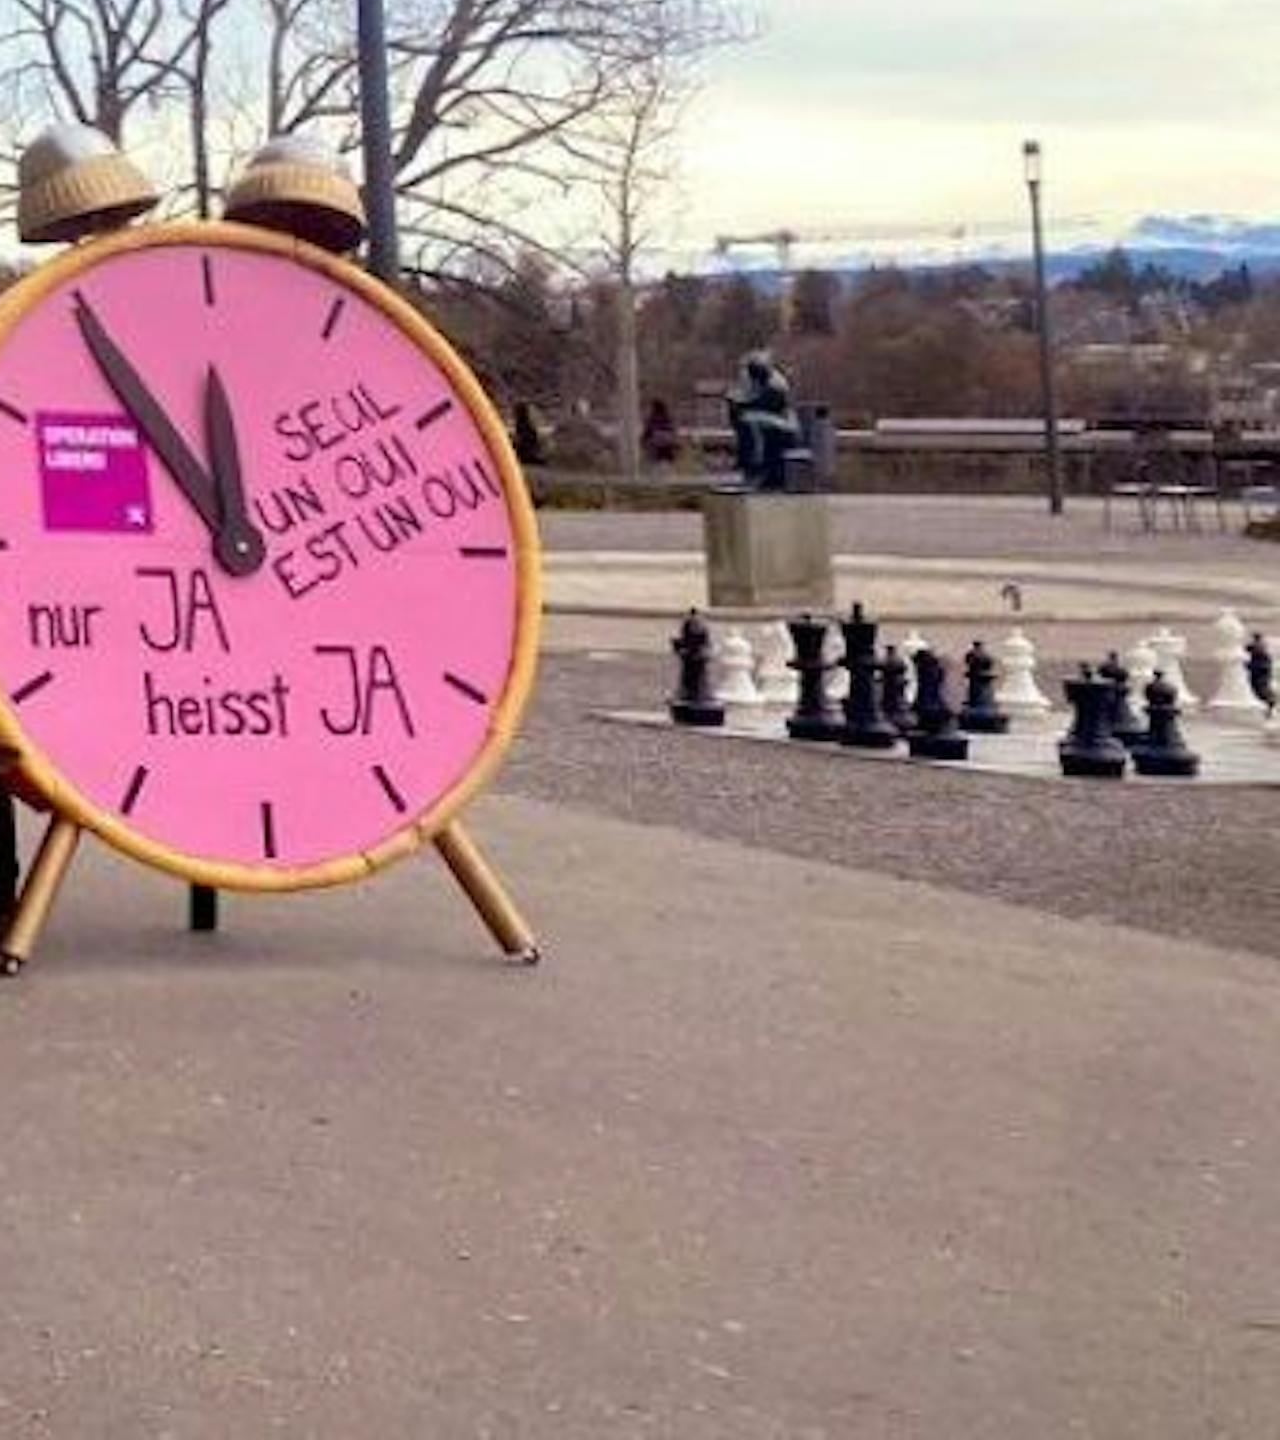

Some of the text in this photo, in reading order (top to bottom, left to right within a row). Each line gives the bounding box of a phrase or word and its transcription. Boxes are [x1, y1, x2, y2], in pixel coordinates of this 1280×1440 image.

[274, 383, 403, 461] SEUL
[255, 434, 418, 533] UN OUI
[272, 458, 501, 597] EST UN OUI
[28, 568, 230, 653] nur JA
[144, 645, 414, 738] heisst JA
